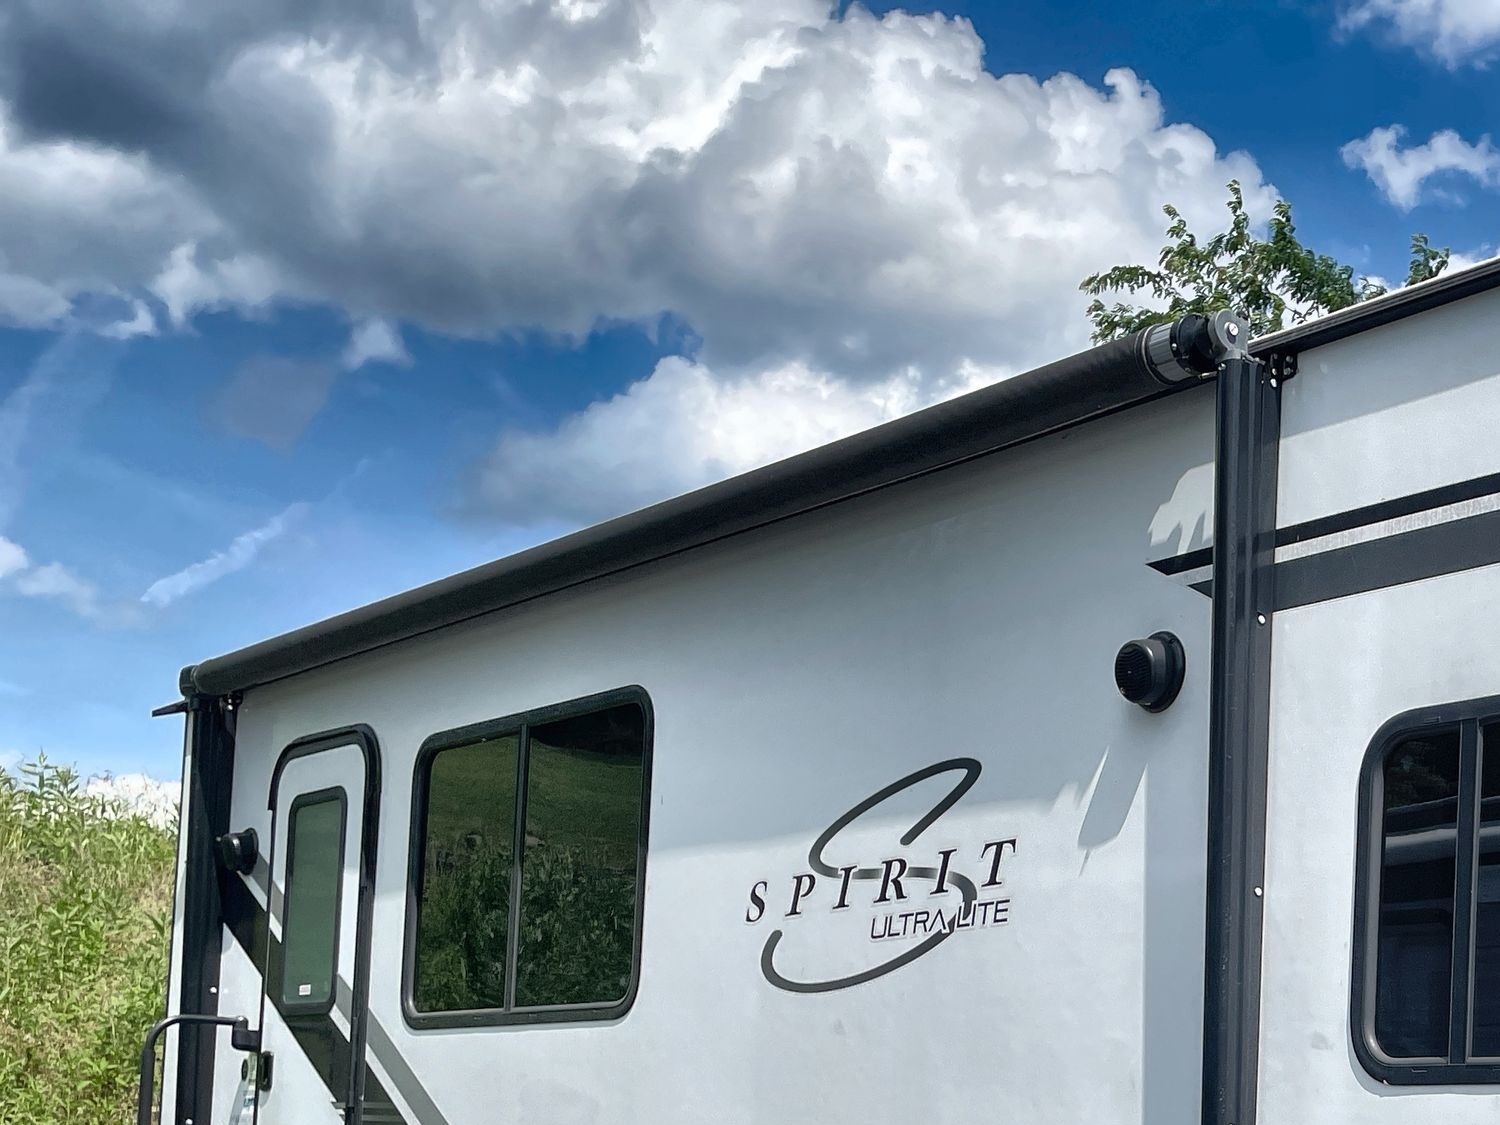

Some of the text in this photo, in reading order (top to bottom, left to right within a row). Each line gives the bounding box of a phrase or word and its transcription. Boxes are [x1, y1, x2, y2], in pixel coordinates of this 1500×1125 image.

[745, 838, 1017, 923] SPIRIT
[870, 899, 1011, 940] ULTRA LITE
